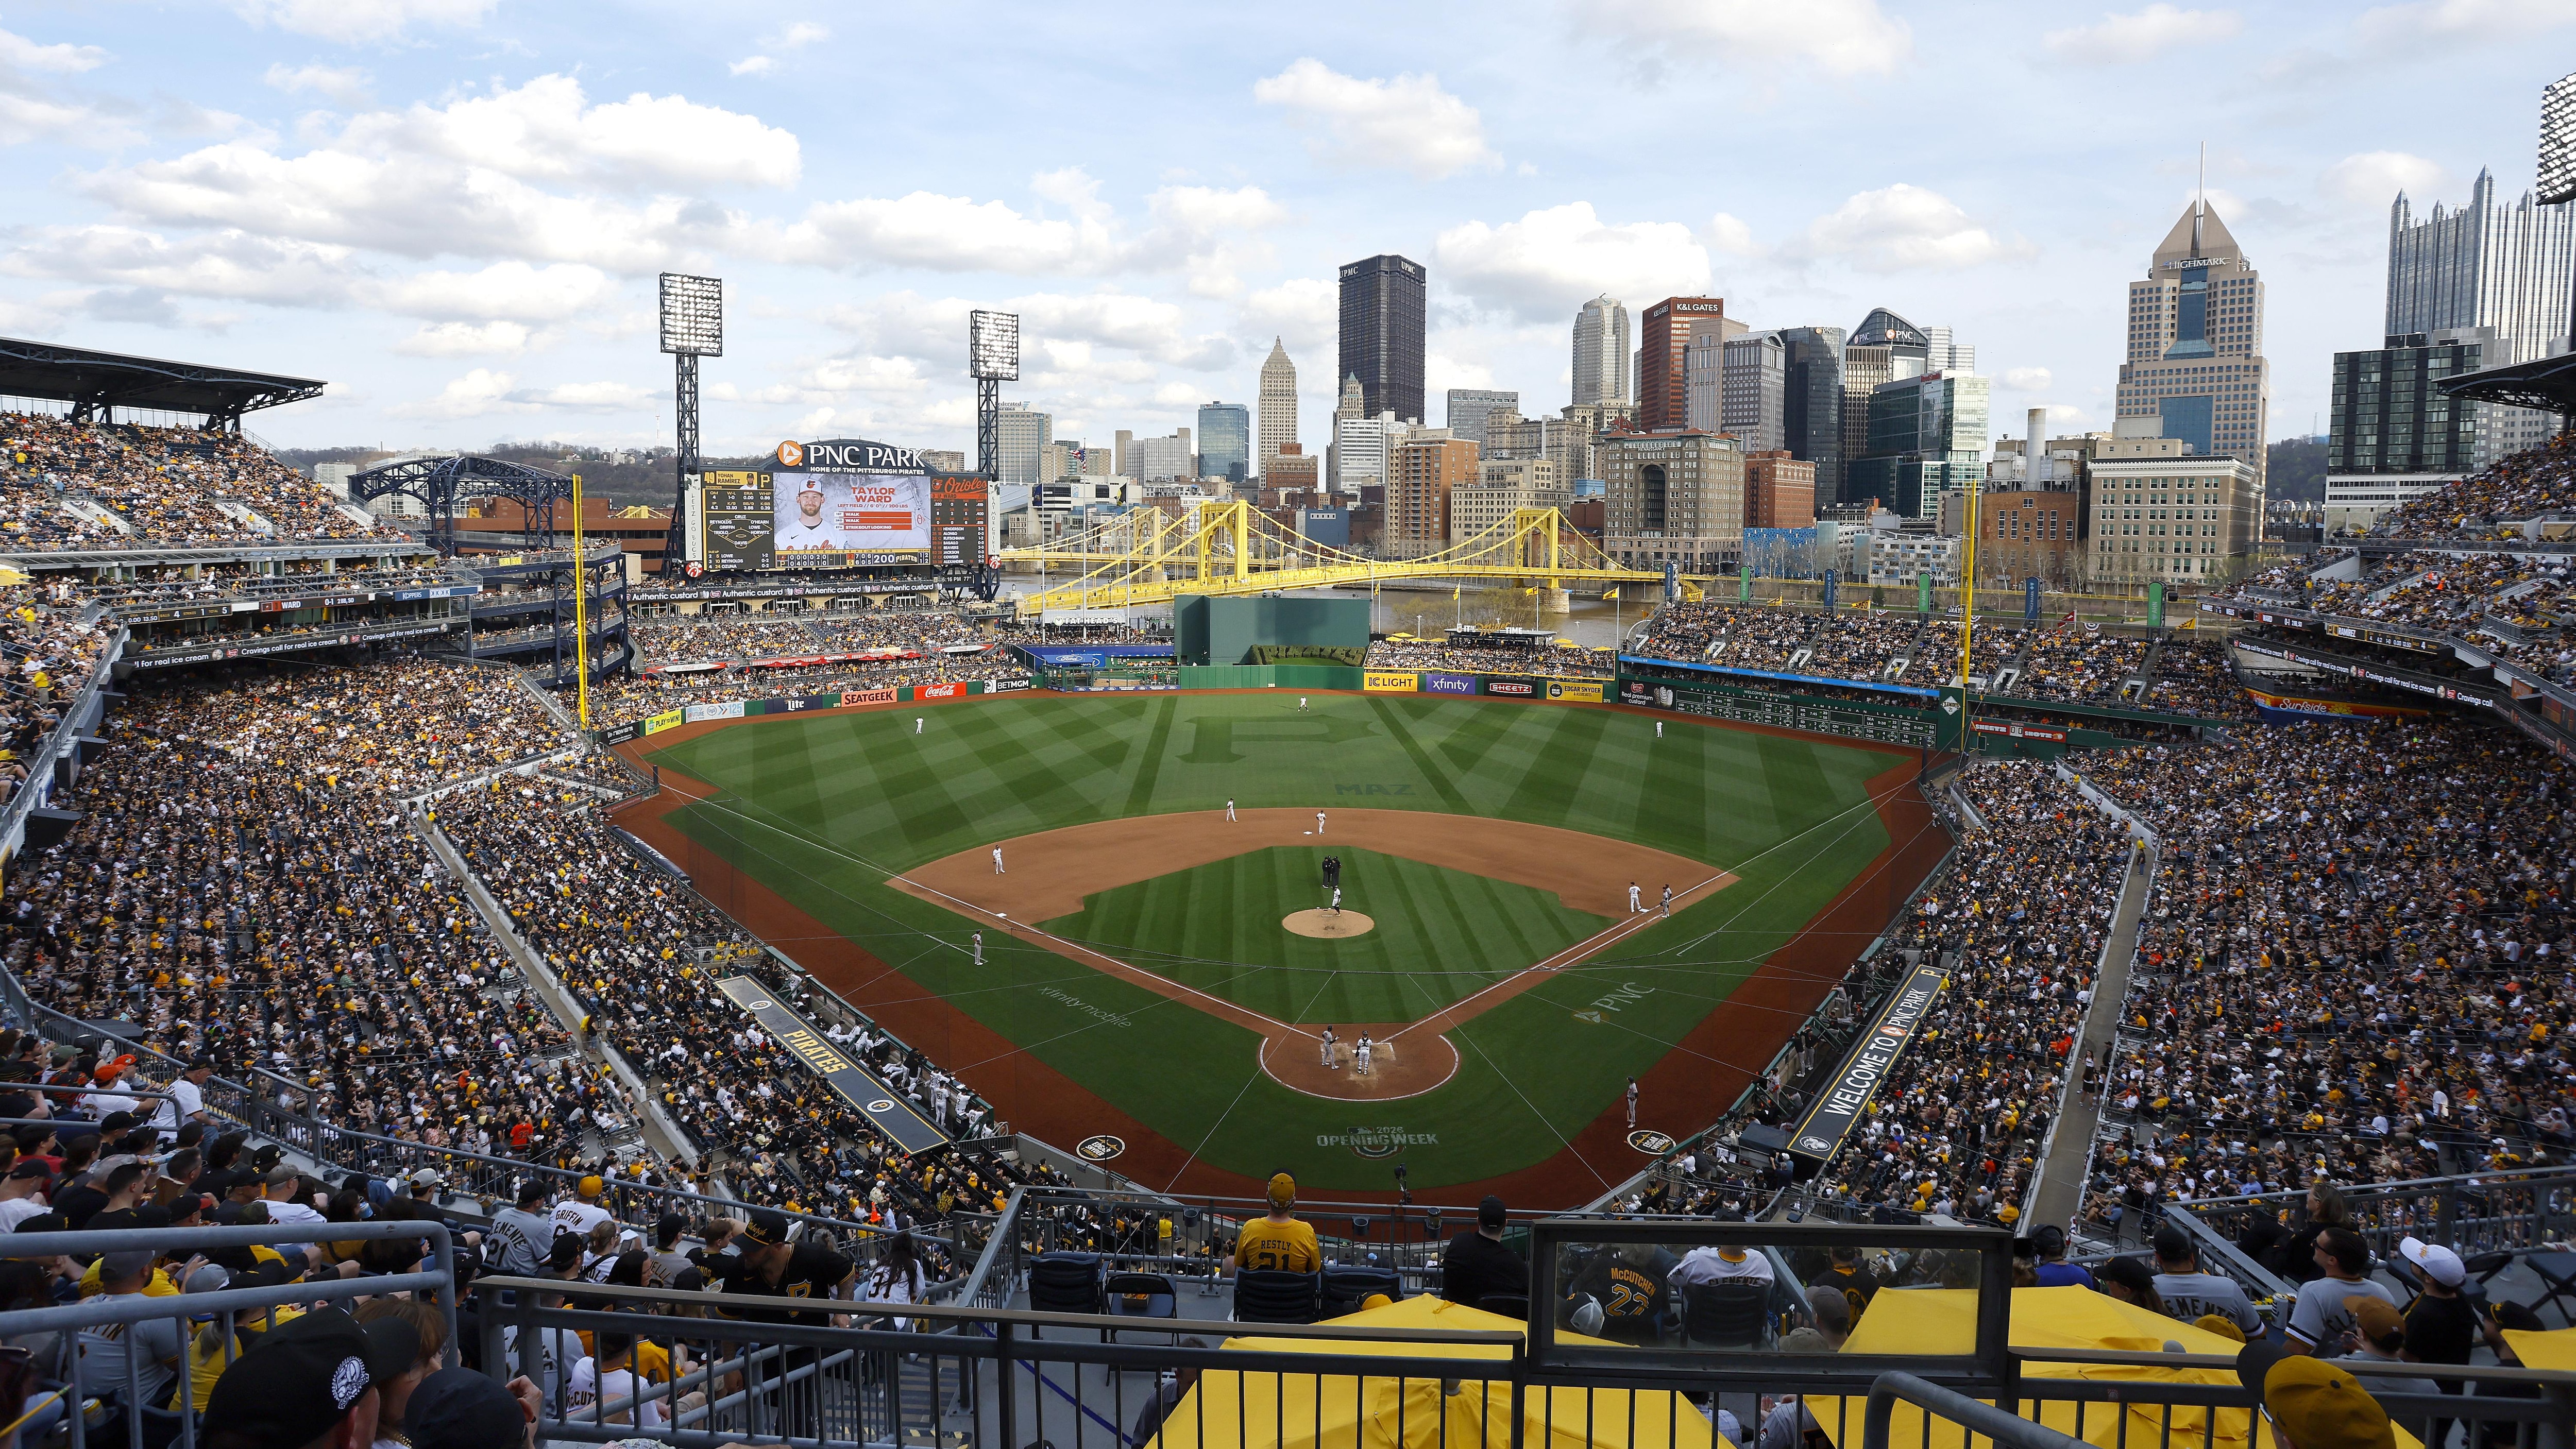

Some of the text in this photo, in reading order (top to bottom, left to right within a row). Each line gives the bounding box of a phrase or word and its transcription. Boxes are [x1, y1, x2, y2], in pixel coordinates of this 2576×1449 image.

[1401, 261, 1415, 274] UPMC
[2170, 258, 2225, 269] HIGHMARK
[1340, 266, 1358, 278] UPMC
[1859, 332, 1870, 342] PNC
[1896, 331, 1913, 339] PNC
[807, 445, 925, 467] PNC PARK
[704, 472, 715, 483] 49
[944, 477, 987, 493] Orioles
[691, 520, 696, 531] GO
[1475, 622, 1511, 636] Miller
[242, 647, 269, 655] Cravings
[2239, 642, 2250, 651] Cravings
[997, 679, 1029, 689] BETMGM
[1369, 677, 1413, 687] IC LIGHT
[1433, 678, 1468, 692] xfinity
[2366, 671, 2435, 694] Cravings cream
[925, 685, 955, 697] Coca-Cola
[845, 690, 893, 705] SEATGEEK
[2458, 692, 2493, 707] Cravings call
[728, 703, 742, 714] 125
[787, 700, 804, 711] Lite
[1813, 704, 1867, 713] AMERICAN
[2280, 698, 2327, 712] Surfside
[656, 714, 680, 727] PLAY WIN!
[1975, 724, 2007, 732] SHEETZ
[1335, 784, 1416, 795] MAZ
[1590, 982, 1655, 1011] PNC
[1038, 987, 1131, 1028] xfinity mobile
[783, 1030, 848, 1073] PIRATES
[1824, 988, 1929, 1116] WELCOME TO PNC PARK
[1317, 1134, 1438, 1146] OPENING WEEK
[556, 1209, 583, 1226] GRIFFIN
[1261, 1240, 1291, 1251] RESTLY
[486, 1238, 508, 1268] 21
[1611, 1267, 1656, 1297] McCUTCHEN
